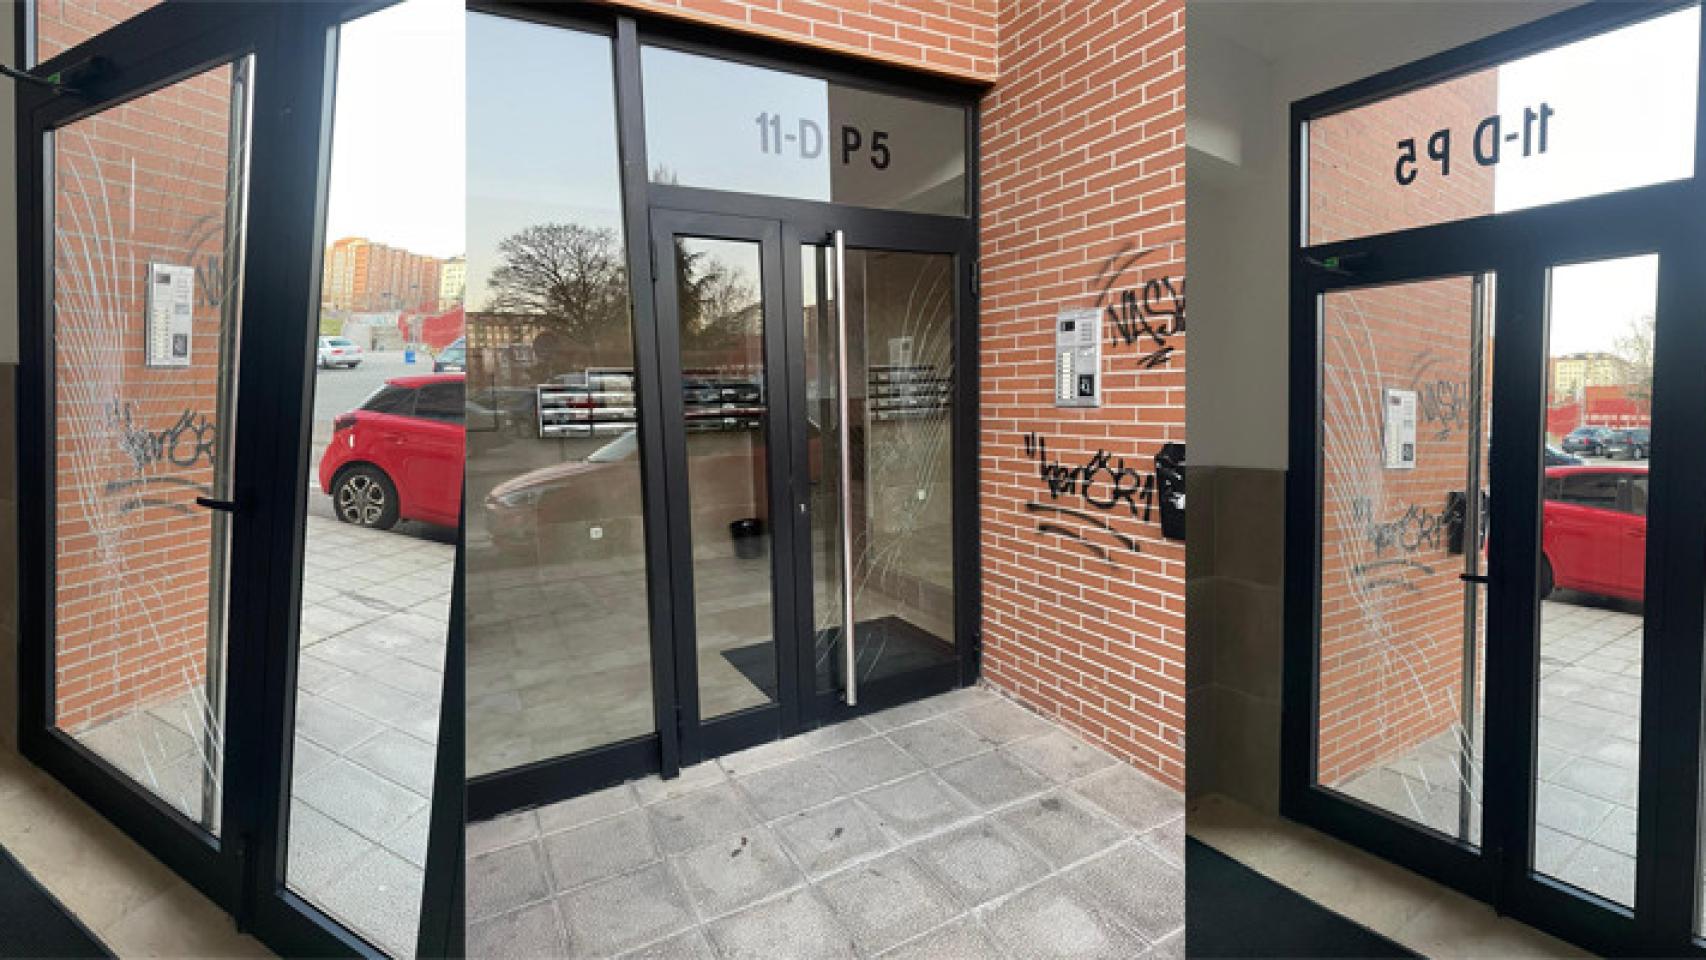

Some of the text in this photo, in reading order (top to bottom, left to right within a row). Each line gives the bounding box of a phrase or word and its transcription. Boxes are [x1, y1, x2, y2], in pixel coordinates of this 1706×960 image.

[755, 112, 891, 170] 11-D P 5
